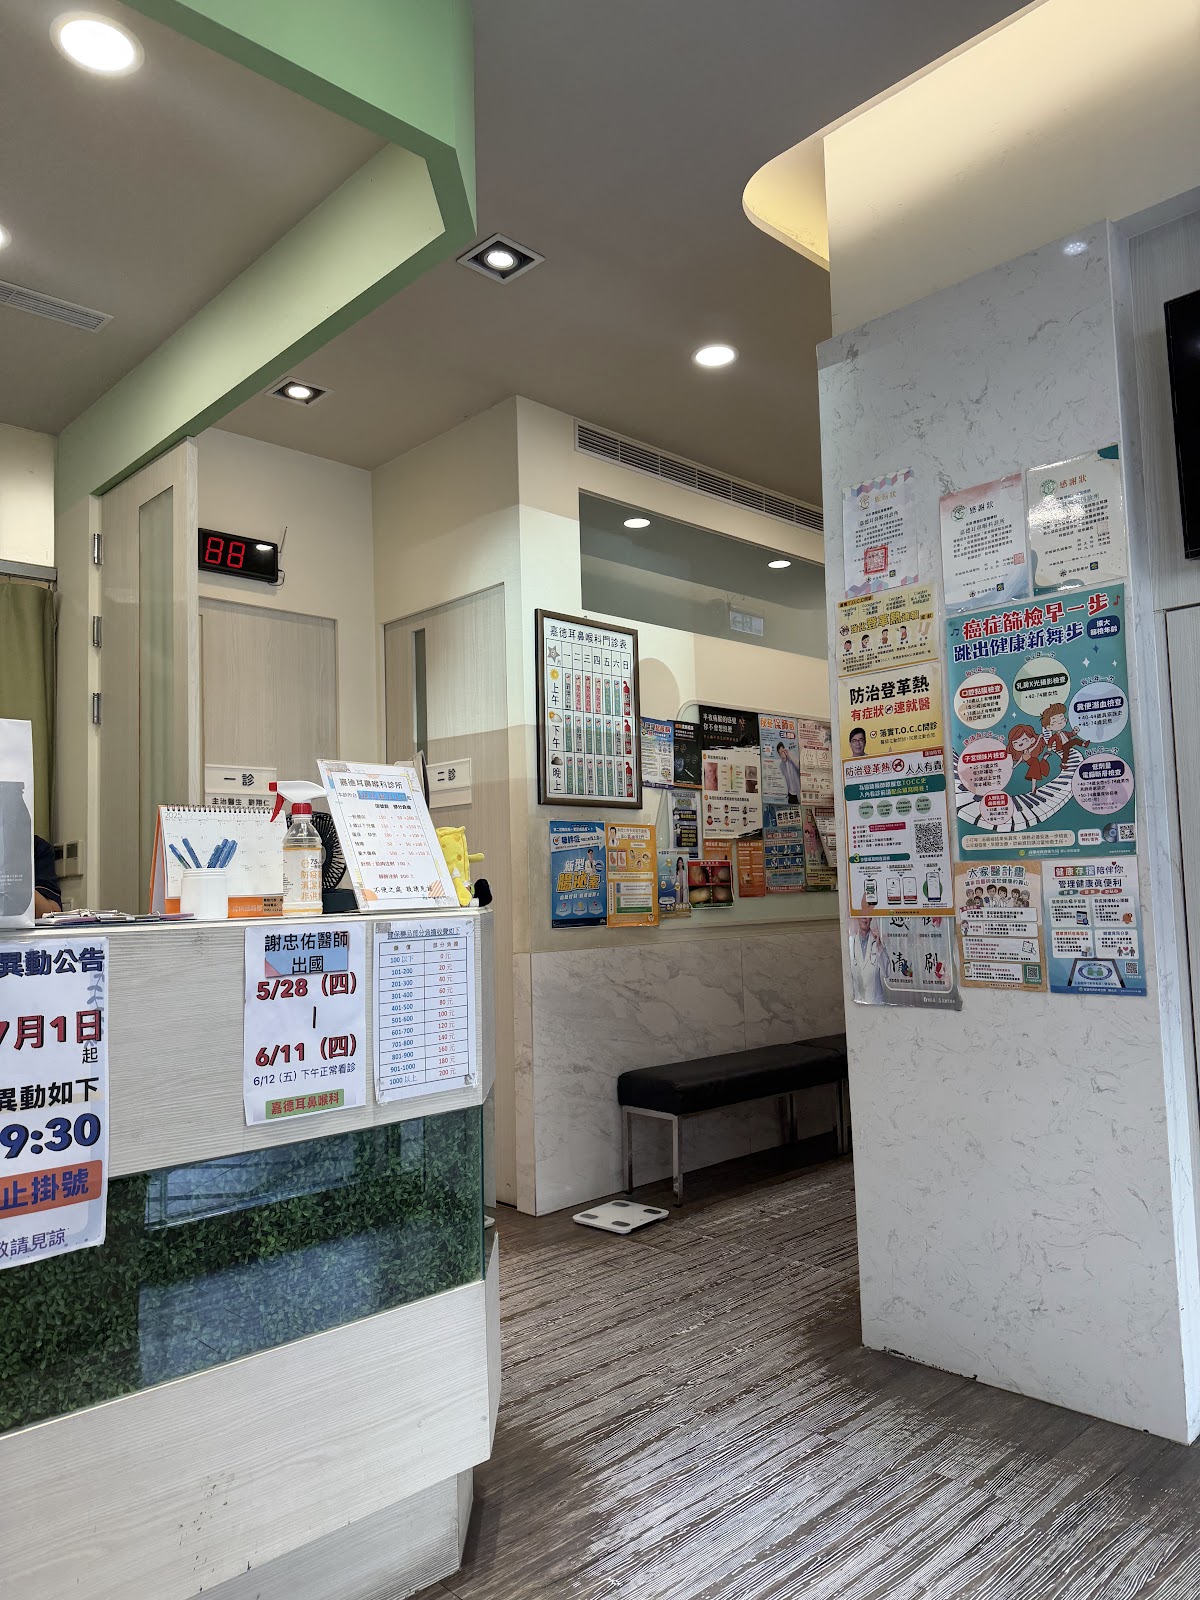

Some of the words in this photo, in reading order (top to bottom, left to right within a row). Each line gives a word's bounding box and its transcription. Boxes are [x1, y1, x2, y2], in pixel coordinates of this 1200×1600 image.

[1060, 474, 1087, 489] 感謝狀
[969, 500, 994, 514] 感謝狀
[204, 537, 245, 569] 88
[963, 593, 1109, 640] 癌症篩檢早一步
[1096, 619, 1110, 627] 擴大
[550, 625, 627, 650] 嘉德耳鼻喉科門診表
[953, 622, 1084, 663] 跳出健康新舞步
[574, 652, 581, 661] 二
[584, 654, 591, 663] 三
[593, 655, 601, 665] 四
[604, 657, 610, 667] 五
[613, 659, 620, 668] 六
[623, 660, 629, 670] 日
[849, 675, 930, 705] 防治登革熱
[962, 685, 1000, 697] 口腔黏膜檢查
[1016, 675, 1065, 690] 乳房X光攝影檢查
[551, 682, 560, 706] 上午
[851, 704, 885, 722] 有症狀
[894, 697, 931, 715] 速就醫
[1077, 698, 1122, 711] 糞便潛血檢查
[552, 725, 560, 748] 下午
[964, 752, 1005, 762] 子宮頸抹片檢查
[437, 768, 456, 782] 二診
[845, 762, 891, 777] 防治登革熱
[906, 760, 942, 775] 人人有責
[1082, 769, 1122, 779] 電腦斷層檢查
[223, 773, 255, 787] 一診
[552, 767, 561, 791] 晚上
[564, 858, 585, 872] 新型
[968, 865, 1025, 878] 大家醫計畫
[556, 871, 601, 893] 腸泌素
[264, 931, 349, 953] 謝忠佑醫師
[0, 947, 105, 978] 異動公告
[292, 955, 324, 974] 出國
[401, 955, 414, 963] 以下
[924, 952, 938, 974] 刷
[391, 968, 413, 976] 101-200
[256, 978, 309, 1001] 5/28
[391, 979, 413, 988] 201-300
[391, 991, 413, 1000] 301-400
[447, 986, 453, 994] 元
[391, 1003, 414, 1011] 401-500
[391, 1015, 414, 1024] 501-600
[391, 1027, 414, 1036] 601-700
[391, 1039, 414, 1048] 701-800
[449, 1032, 455, 1040] 元
[82, 1047, 98, 1064] 起
[255, 1043, 305, 1067] 6/11
[391, 1051, 414, 1061] 801-900
[449, 1044, 455, 1052] 元
[253, 1074, 275, 1087] 6/12
[301, 1063, 356, 1081] 下午正常看診
[390, 1063, 416, 1073] 901-1000
[389, 1077, 403, 1086] 1000
[404, 1075, 417, 1083] 以上
[0, 1077, 99, 1112] 異動如下
[271, 1091, 340, 1115] 嘉德耳鼻喉科
[0, 1112, 101, 1159] 9:30
